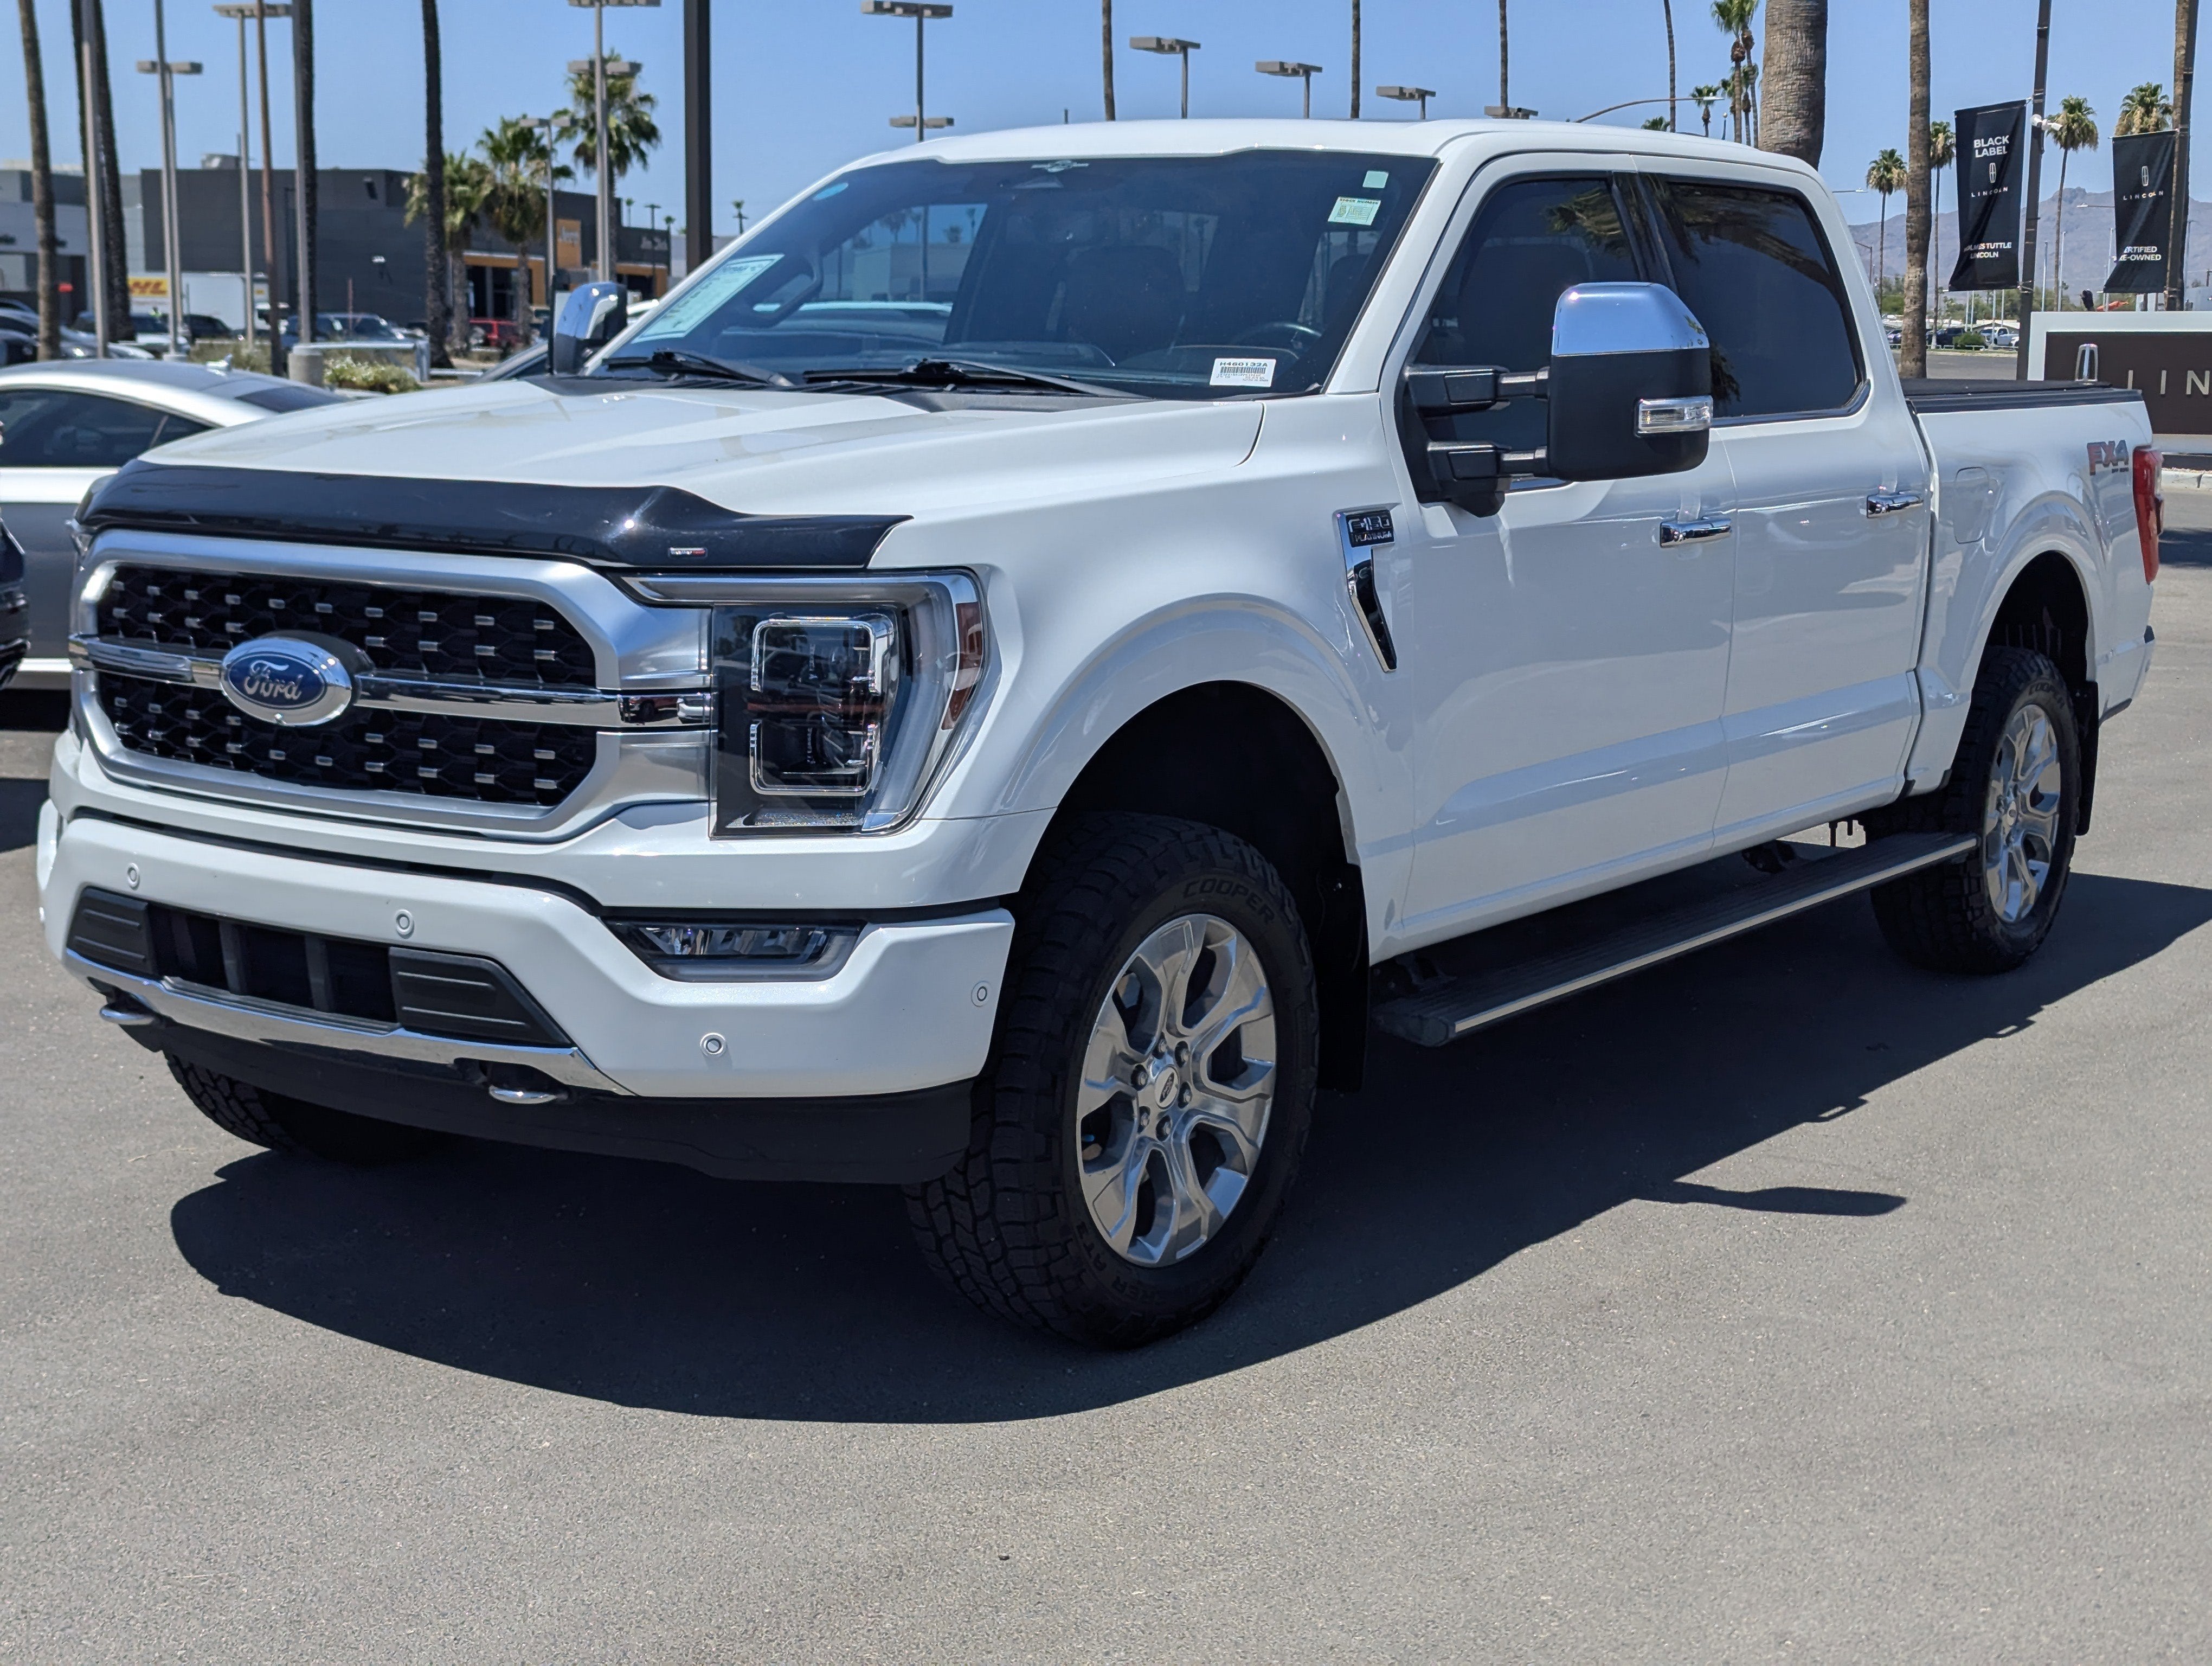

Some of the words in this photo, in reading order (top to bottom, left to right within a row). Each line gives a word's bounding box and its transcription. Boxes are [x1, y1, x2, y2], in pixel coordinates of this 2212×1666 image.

[1973, 135, 2010, 148] BLACK
[1975, 146, 2008, 158] LABEL
[1971, 187, 2008, 197] LINCOLN
[1970, 251, 1999, 259] LINCOLN
[130, 279, 167, 295] HL
[2086, 440, 2129, 476] FX4
[244, 659, 302, 700] Ford
[1183, 879, 1275, 924] COOPER
